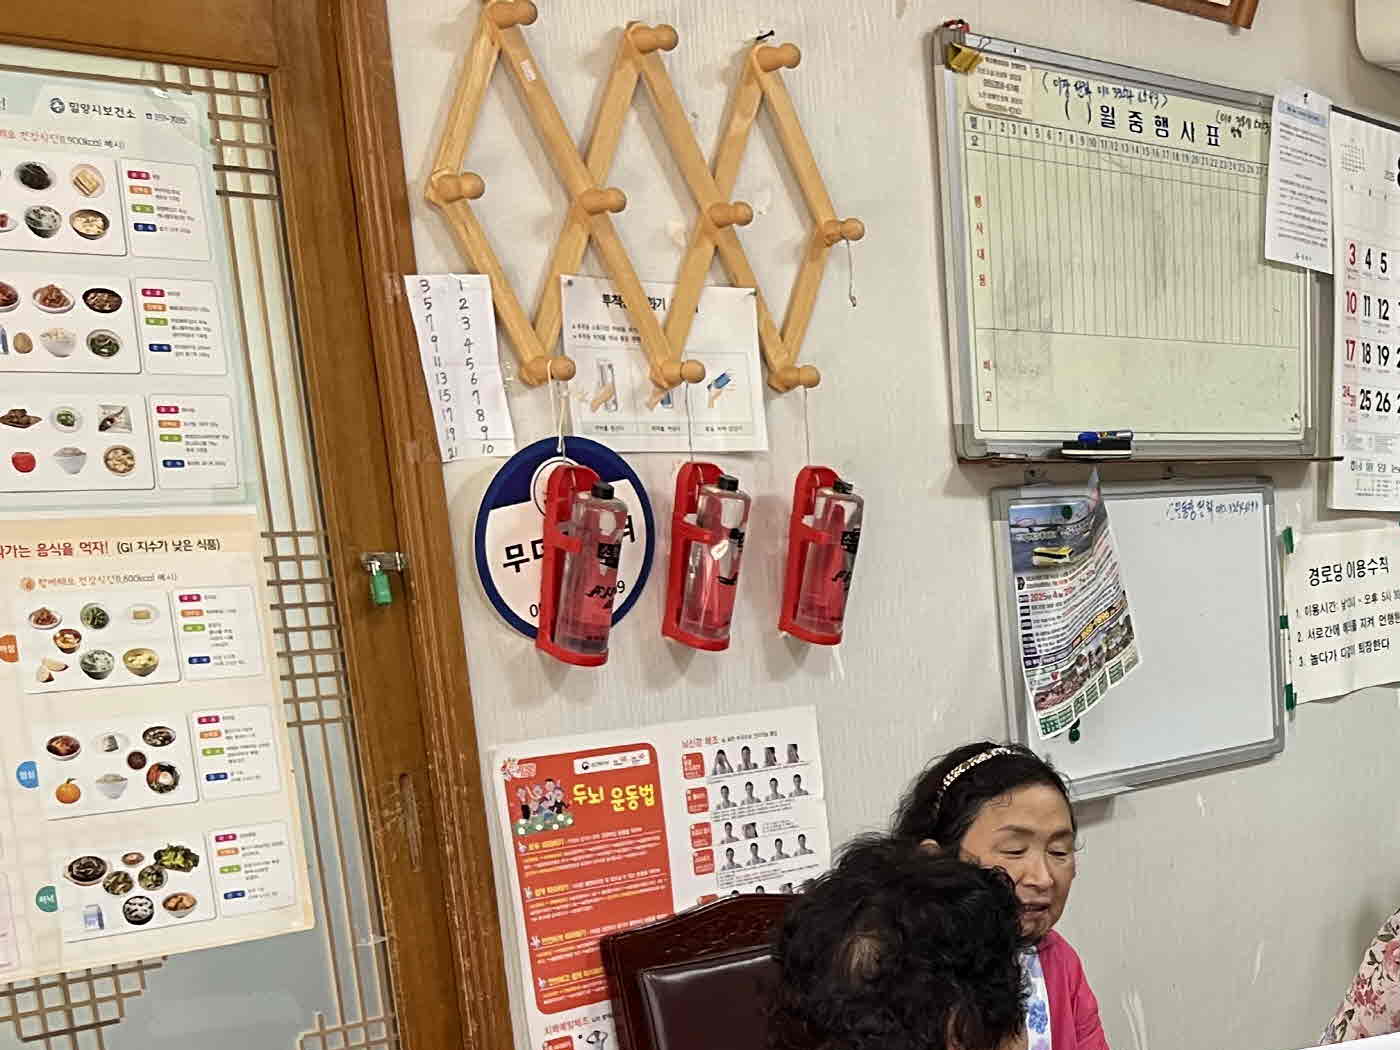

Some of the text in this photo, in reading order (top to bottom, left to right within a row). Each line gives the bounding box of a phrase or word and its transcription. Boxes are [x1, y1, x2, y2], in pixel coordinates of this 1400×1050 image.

[1349, 243, 1356, 265] 3
[1364, 248, 1372, 270] 4
[1380, 252, 1387, 274] 5
[419, 280, 464, 293] 3 1
[424, 297, 469, 310] 5 2
[1346, 291, 1357, 314] 10
[1363, 295, 1371, 317] 11
[1377, 298, 1390, 321] 12
[425, 315, 470, 331] 7 3
[432, 336, 473, 355] 9 4
[1346, 340, 1356, 361] 17
[1361, 343, 1371, 364] 18
[1377, 345, 1389, 367] 19
[433, 356, 474, 371] 11 5
[435, 371, 478, 385] 13 6
[439, 389, 481, 406] 15 7
[1360, 388, 1371, 411] 25
[1375, 391, 1391, 413] 26
[476, 408, 485, 422] 8
[445, 425, 488, 442] 19 9
[481, 443, 494, 455] 10
[37, 542, 73, 557] 음식을
[80, 541, 109, 555] 먹자!
[137, 540, 168, 553] 지수가
[172, 539, 193, 552] 낮은
[1308, 556, 1390, 587] 경로당 이용수칙
[1364, 593, 1378, 605] 오후
[1381, 591, 1392, 602] 5시
[1307, 624, 1341, 640] 서로간에
[1360, 616, 1375, 628] 지켜
[1358, 638, 1390, 654] 퇴장한다
[573, 783, 655, 812] 두뇌 운동법
